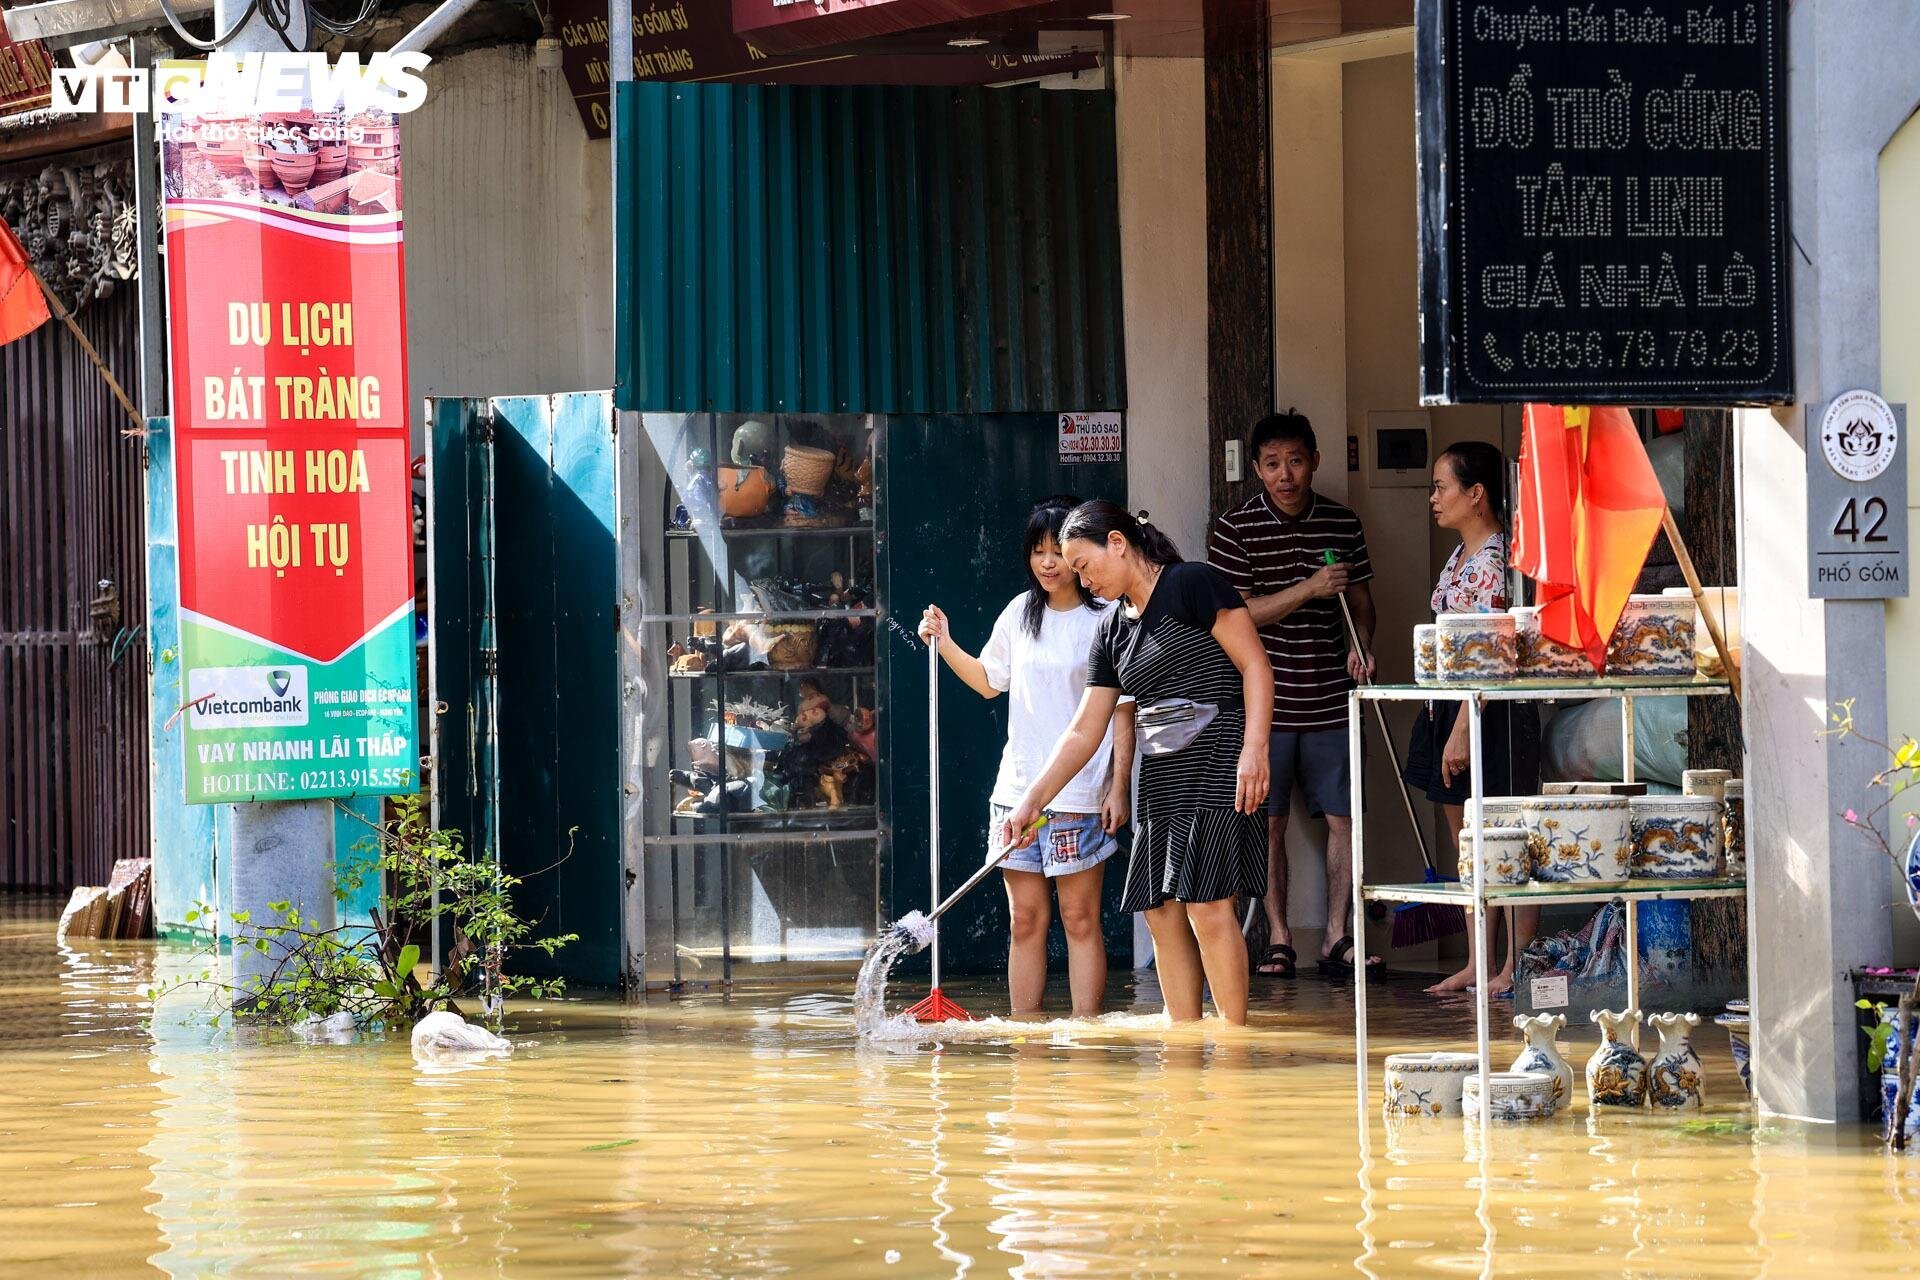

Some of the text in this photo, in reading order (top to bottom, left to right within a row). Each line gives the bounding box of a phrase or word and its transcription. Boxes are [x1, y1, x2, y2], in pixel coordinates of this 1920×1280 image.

[562, 17, 588, 48] CÁC
[643, 3, 674, 34] GỐM
[671, 1, 688, 30] SỨ
[1473, 5, 1561, 50] Chuyên:
[1567, 3, 1608, 43] Bán
[1614, 7, 1668, 44] Buôn
[1687, 5, 1726, 44] Bán
[1733, 4, 1757, 45] Lẻ
[634, 50, 656, 77] BÁT
[654, 45, 694, 74] TRÀNG
[1471, 63, 1534, 149] ĐỒ
[1644, 73, 1761, 150] CÚNG
[1516, 163, 1723, 237] TÂM LINH
[1482, 251, 1756, 308] GIÁ NHÀ LÒ
[228, 302, 353, 356] DU LỊCH
[1522, 330, 1760, 369] 0856.79.79.29
[204, 366, 381, 420] BÁT TRÀNG
[1076, 422, 1090, 434] THỦ
[1104, 424, 1119, 434] SAO
[220, 449, 370, 495] TINH HOA
[1833, 496, 1888, 543] 42
[247, 514, 349, 578] HỘI TỤ
[1818, 560, 1899, 582] PHỐ GỐM
[195, 695, 302, 716] Vietcombank
[198, 730, 408, 764] VAY NHANH LÃI THẤP
[203, 773, 295, 794] HOTLINE:
